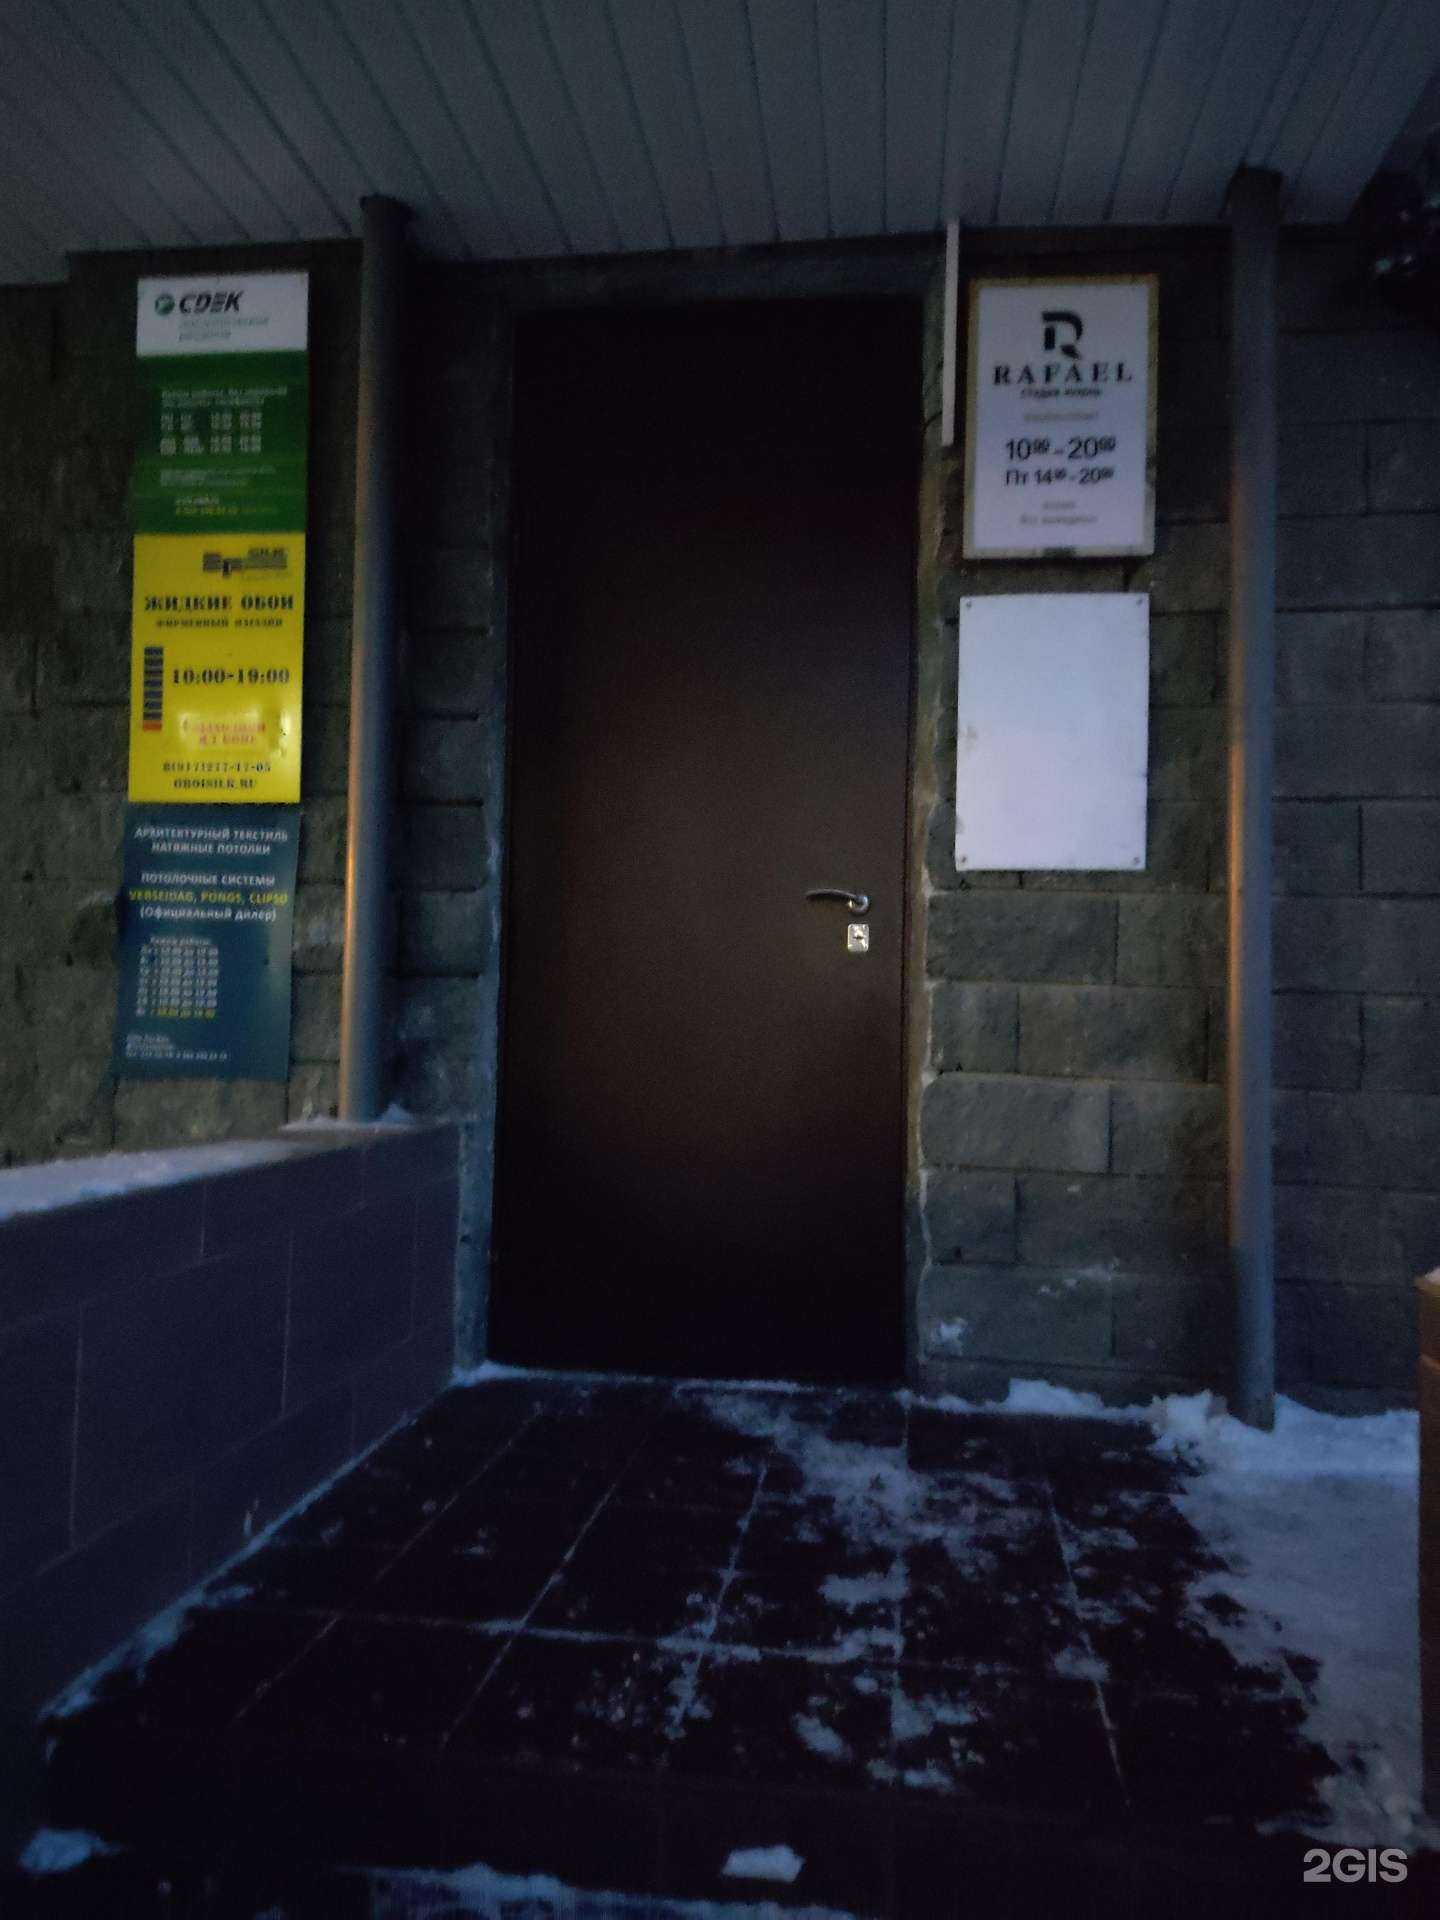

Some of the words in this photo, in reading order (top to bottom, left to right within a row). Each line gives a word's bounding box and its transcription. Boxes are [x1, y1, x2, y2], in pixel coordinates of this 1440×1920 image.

[179, 291, 244, 313] CDEK
[994, 361, 1133, 385] RAFAEL
[145, 595, 231, 612] ЖИДКИЕ
[240, 594, 293, 610] ОБОИ
[172, 668, 290, 685] 10:00-19:00
[134, 826, 230, 840] АРХИТЕКТУРНЫЙ
[233, 829, 288, 841] ТЕКСТИЛЬ
[151, 842, 213, 854] НАТЯЖНЫЕ
[217, 843, 271, 855] ПОТОЛКИ
[141, 872, 218, 884] ПОТОЛОЧНЫЕ
[221, 873, 275, 885] СИСТЕМЫ
[140, 906, 232, 920] (Официальный
[235, 909, 277, 922] дилер)
